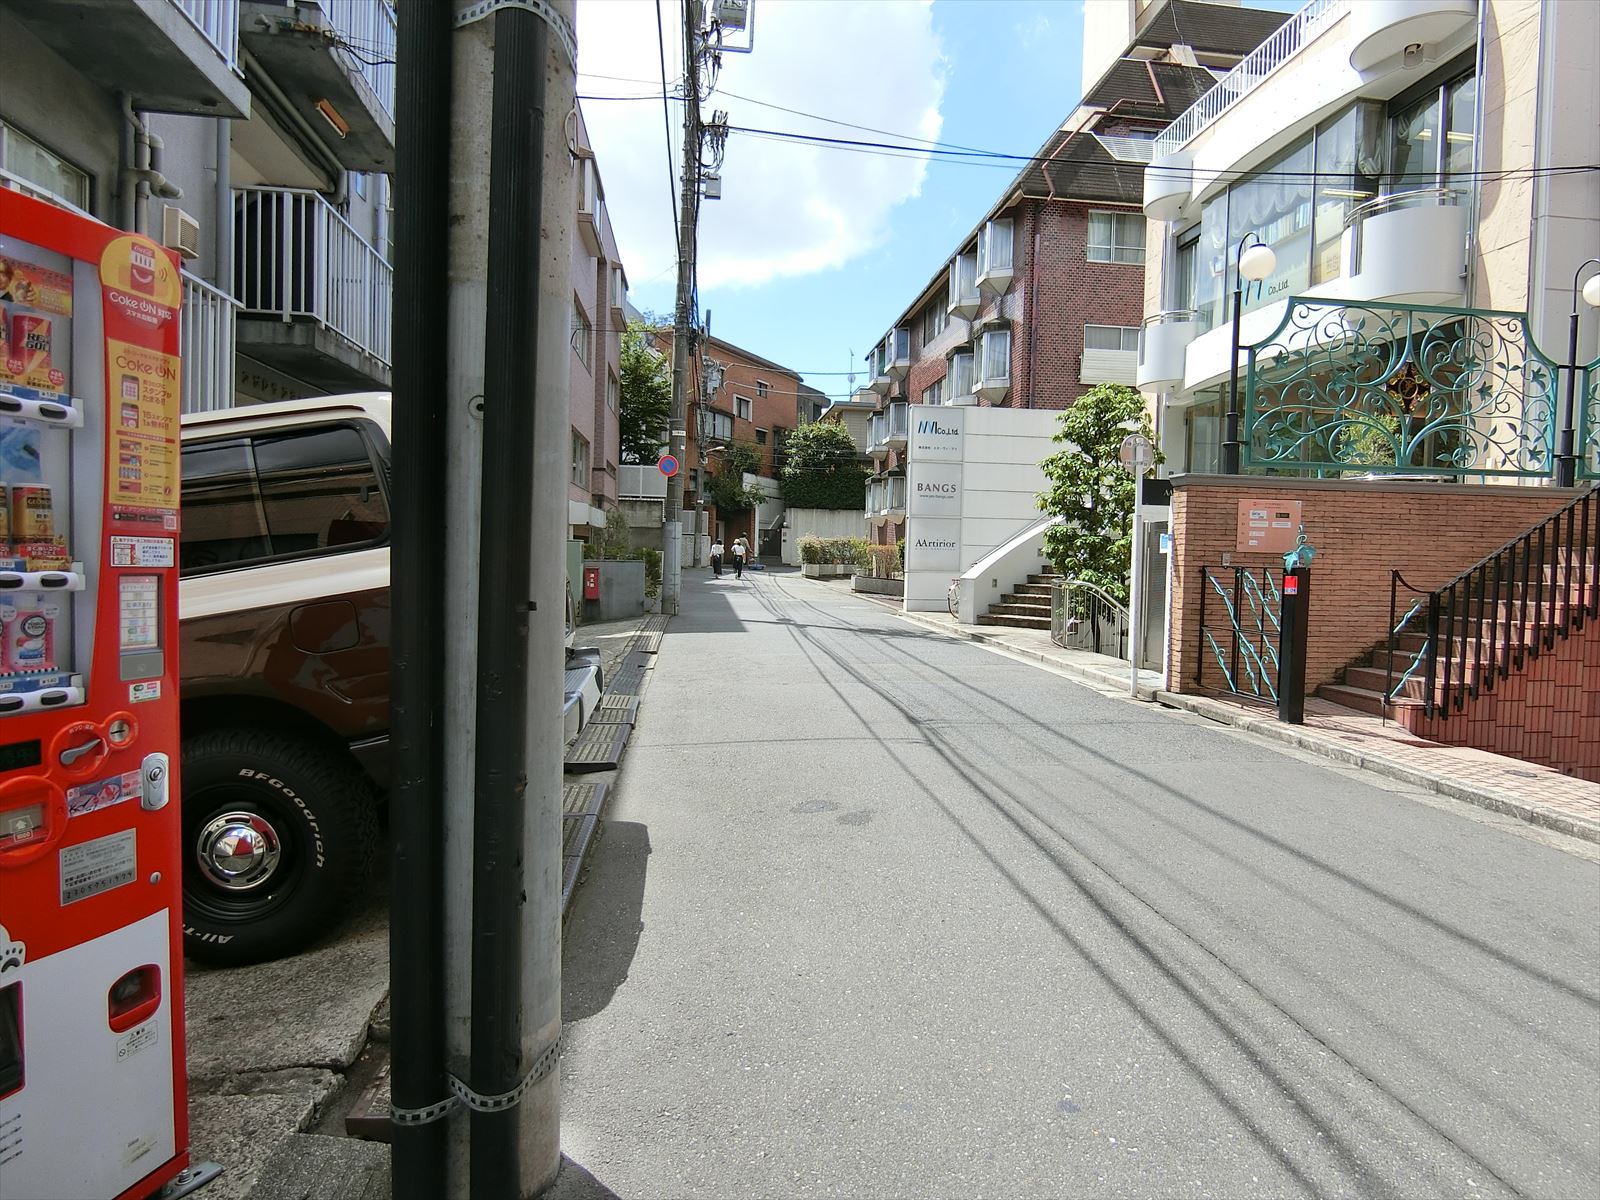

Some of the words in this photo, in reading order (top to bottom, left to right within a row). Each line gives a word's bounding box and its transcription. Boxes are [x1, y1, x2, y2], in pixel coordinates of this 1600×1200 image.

[110, 291, 138, 309] Coke
[140, 300, 156, 315] ON
[116, 355, 153, 375] Coke
[155, 365, 176, 381] ON
[917, 482, 957, 493] BANGS
[239, 768, 325, 868] BFGoodrich
